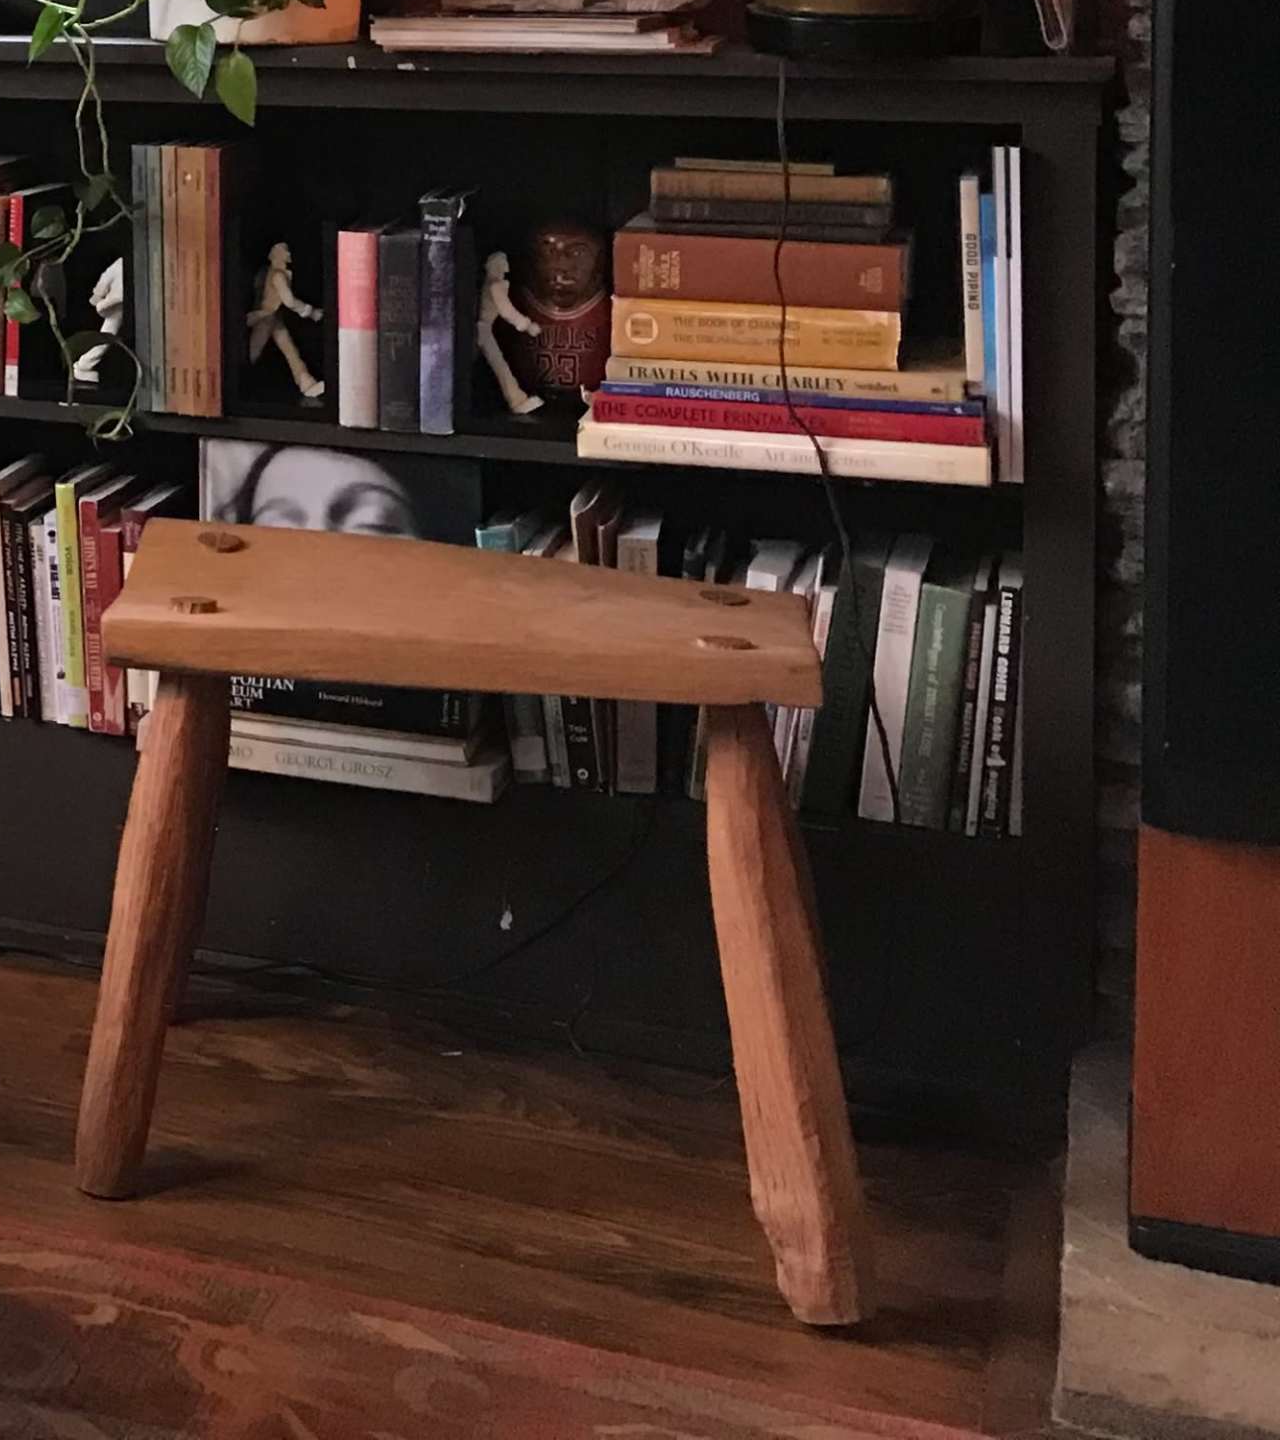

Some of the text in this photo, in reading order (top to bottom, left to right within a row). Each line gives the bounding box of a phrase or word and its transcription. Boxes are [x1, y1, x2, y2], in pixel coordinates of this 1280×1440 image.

[966, 233, 980, 311] GOOD PIPING
[672, 316, 696, 327] THE
[698, 317, 728, 329] BOOK
[730, 318, 745, 329] OF
[672, 334, 696, 344] THE
[536, 351, 580, 388] 23
[627, 365, 698, 382] TRAVELS
[708, 370, 755, 386] WITH
[762, 373, 847, 392] CHARLEY
[664, 386, 761, 403] RAUSCHENBERG
[600, 400, 627, 416] THE
[633, 403, 719, 422] COMPLETE
[602, 434, 666, 455] Georgia
[670, 440, 744, 459] O'Keeffe
[762, 448, 787, 463] Art
[790, 453, 817, 465] and
[930, 604, 947, 650] Complete
[997, 591, 1015, 655] LEONARD
[230, 676, 296, 692] POLITAN
[231, 685, 264, 700] EUM
[993, 656, 1011, 702] COHEN
[991, 706, 1006, 741] Book
[274, 751, 340, 772] GEORGE
[341, 759, 393, 780] GROSZ
